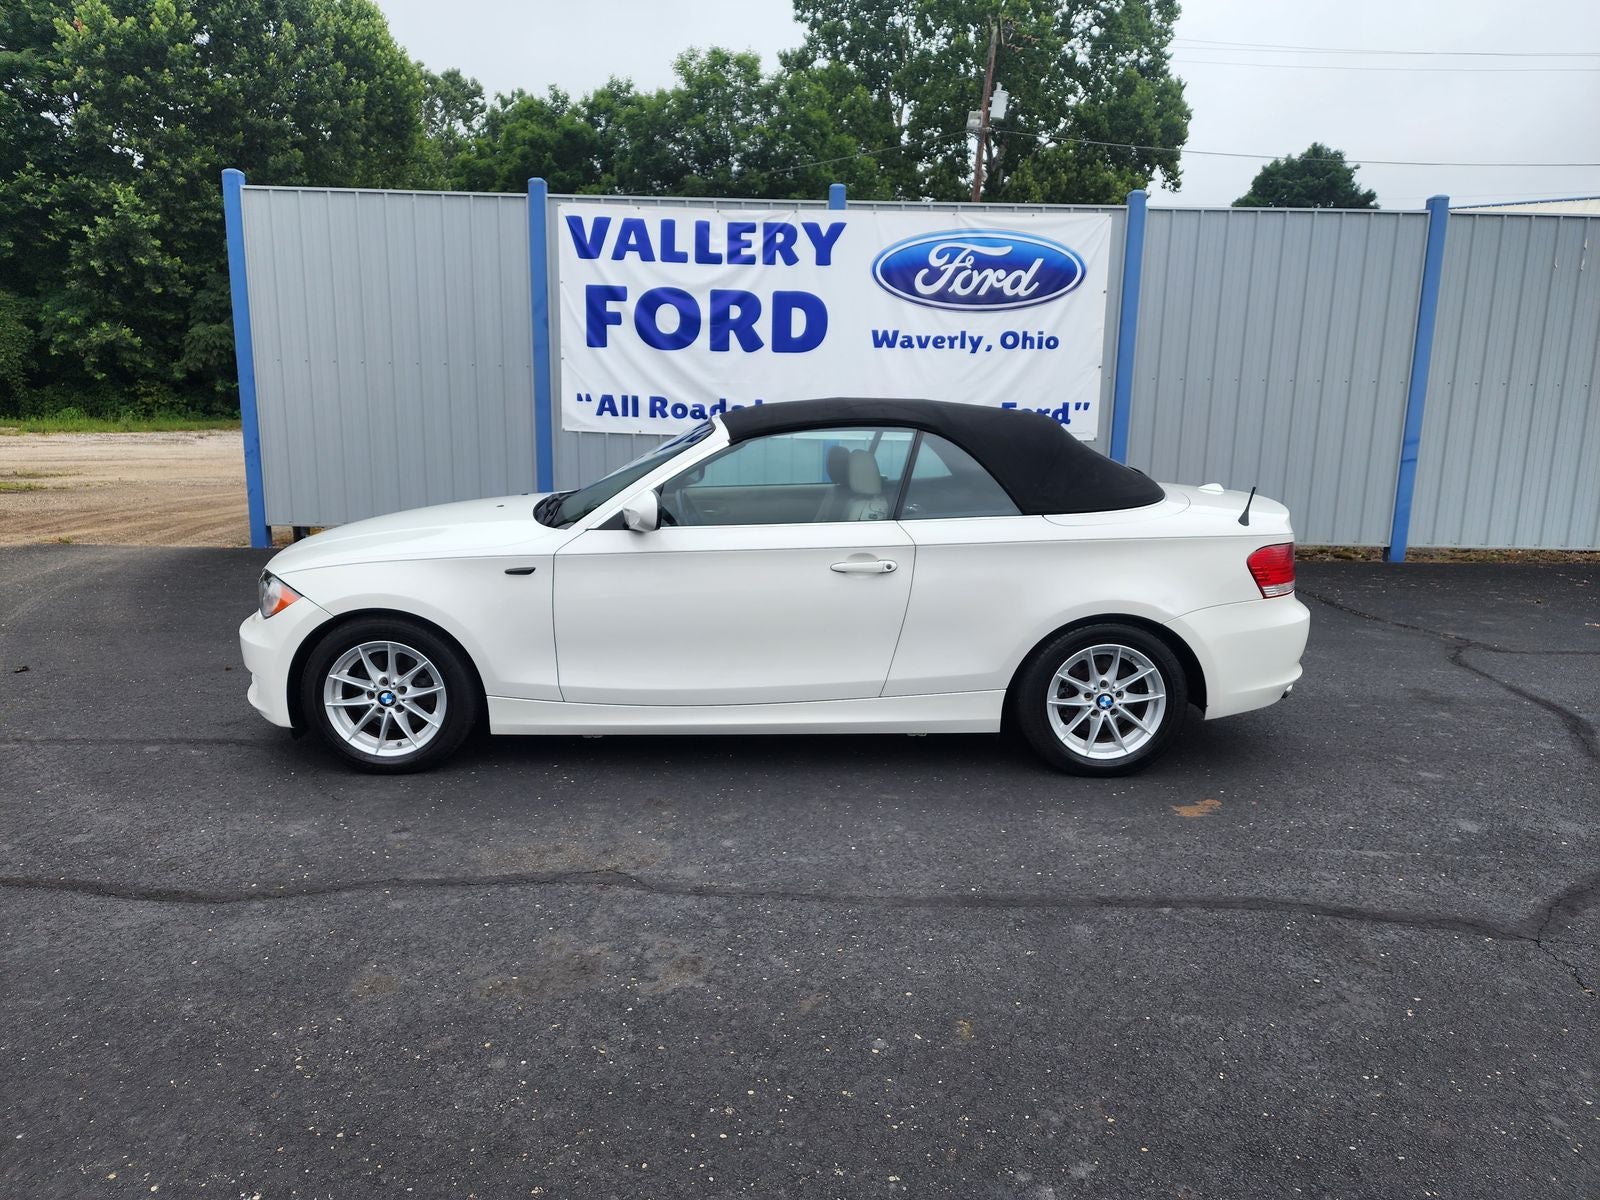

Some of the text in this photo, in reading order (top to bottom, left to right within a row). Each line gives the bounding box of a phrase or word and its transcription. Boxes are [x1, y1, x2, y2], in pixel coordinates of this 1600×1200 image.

[565, 215, 847, 266] VALLERY
[913, 242, 1044, 297] Ford
[585, 284, 828, 353] FORD
[871, 329, 1060, 353] Waverly, Ohio
[576, 393, 639, 418] “All
